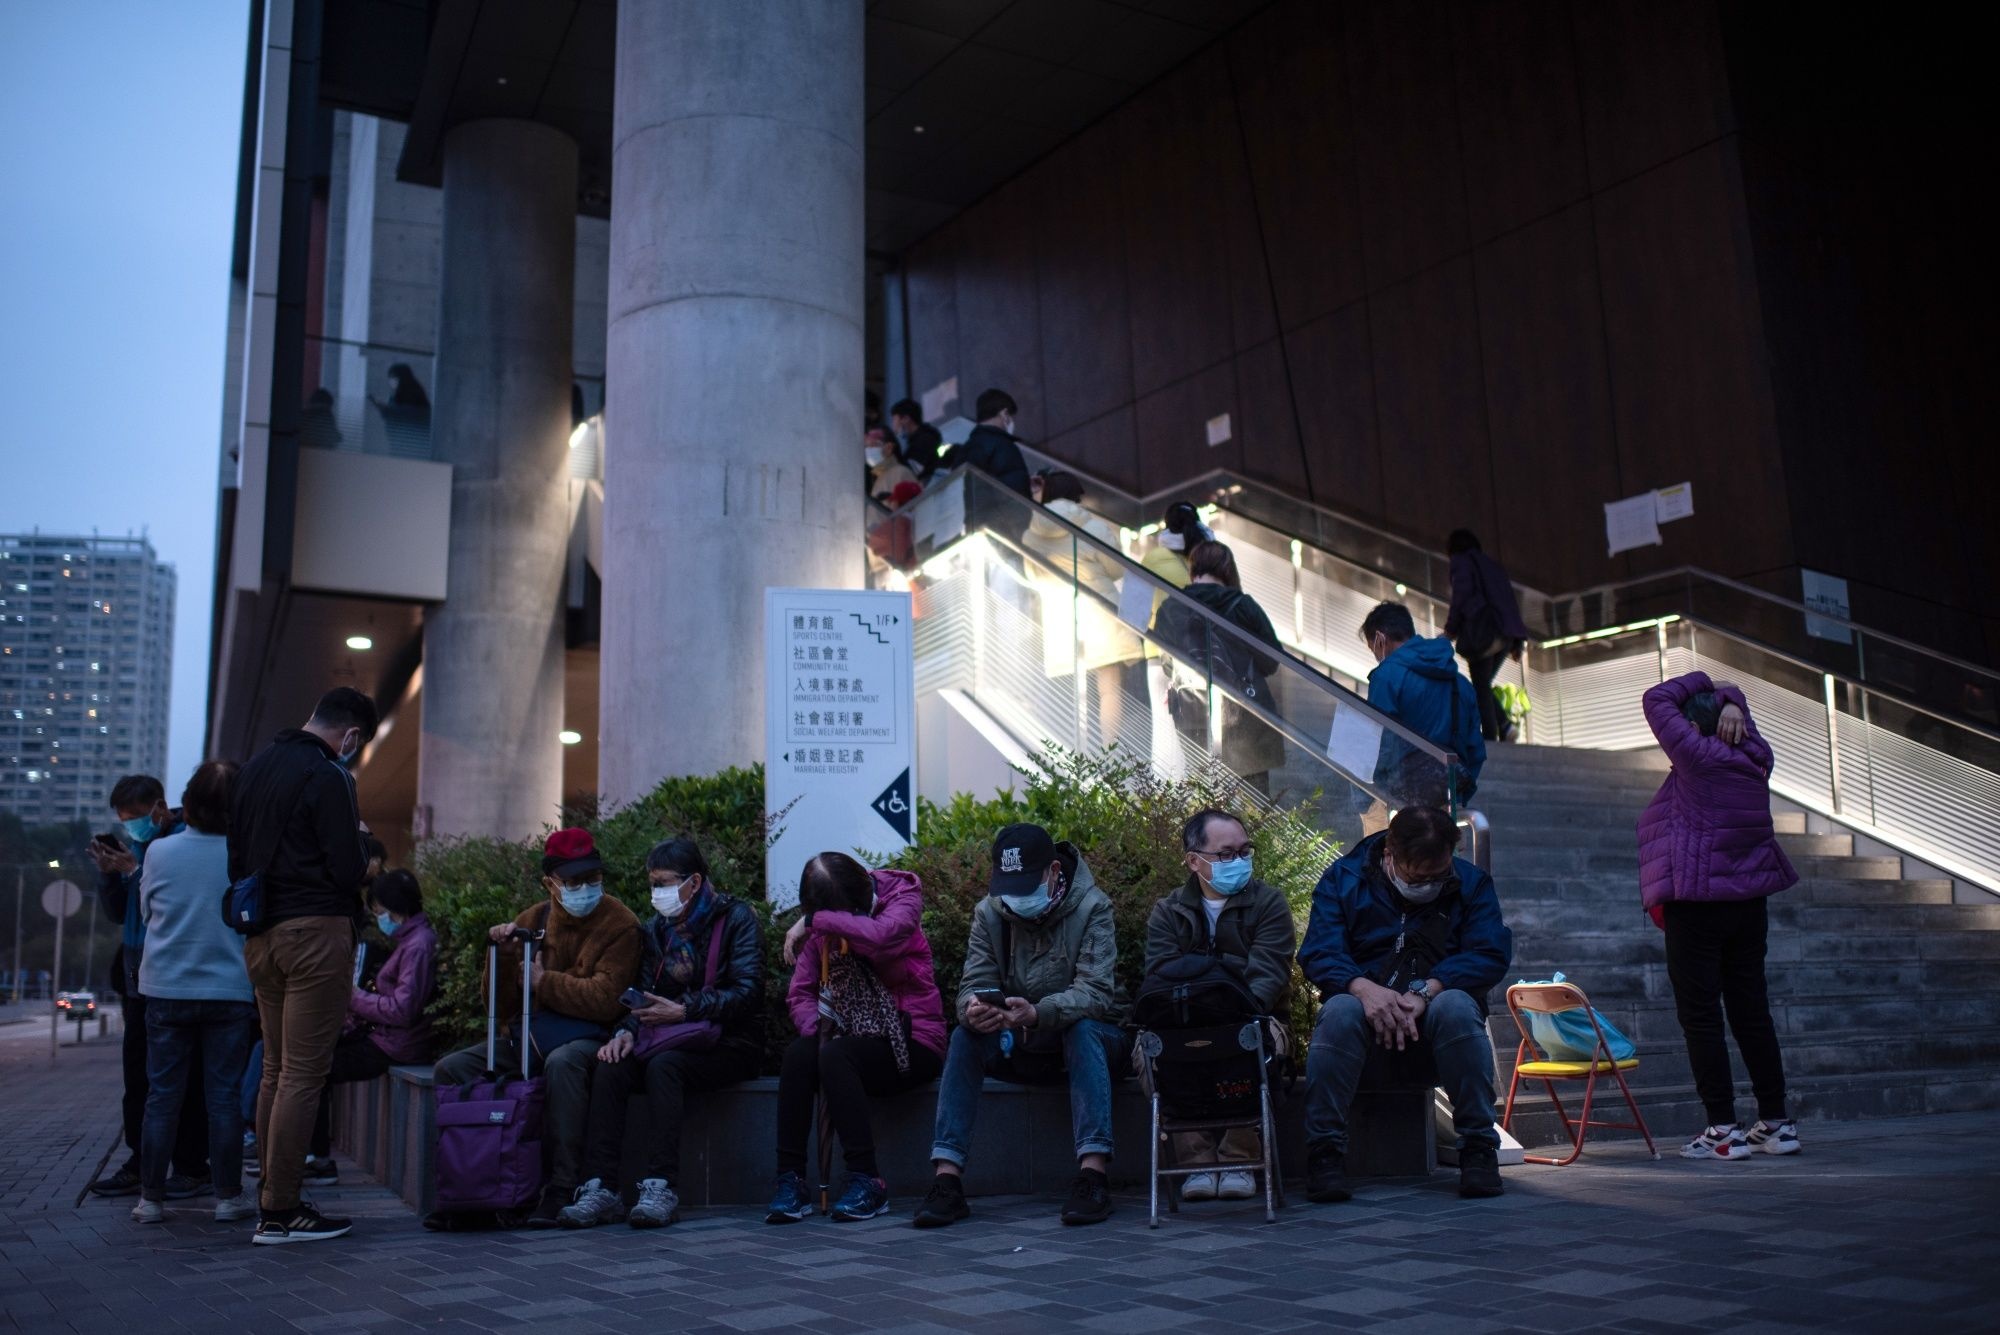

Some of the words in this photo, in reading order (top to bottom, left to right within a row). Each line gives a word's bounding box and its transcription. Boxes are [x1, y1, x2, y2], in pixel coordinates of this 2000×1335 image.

[794, 616, 834, 630] 體育館
[876, 615, 890, 626] 1/F
[794, 632, 816, 640] SPORTS
[794, 646, 848, 660] 社區會堂
[794, 662, 831, 671] COMMUNITY
[833, 663, 848, 672] HALL
[794, 678, 864, 692] 入境事務處
[794, 694, 836, 702] IMMIGRATION
[838, 695, 879, 704] DEPARTMENT
[794, 711, 864, 726] 社會福利署
[794, 728, 816, 736] SOCIAL
[818, 728, 847, 736] WELFARE
[848, 728, 890, 736] DEPARTMENT
[794, 749, 864, 763] 婚姻登記處
[794, 766, 826, 774] MARRIAGE
[828, 766, 858, 774] REGISTRY
[1003, 848, 1020, 858] NEW
[1001, 856, 1022, 866] YORK
